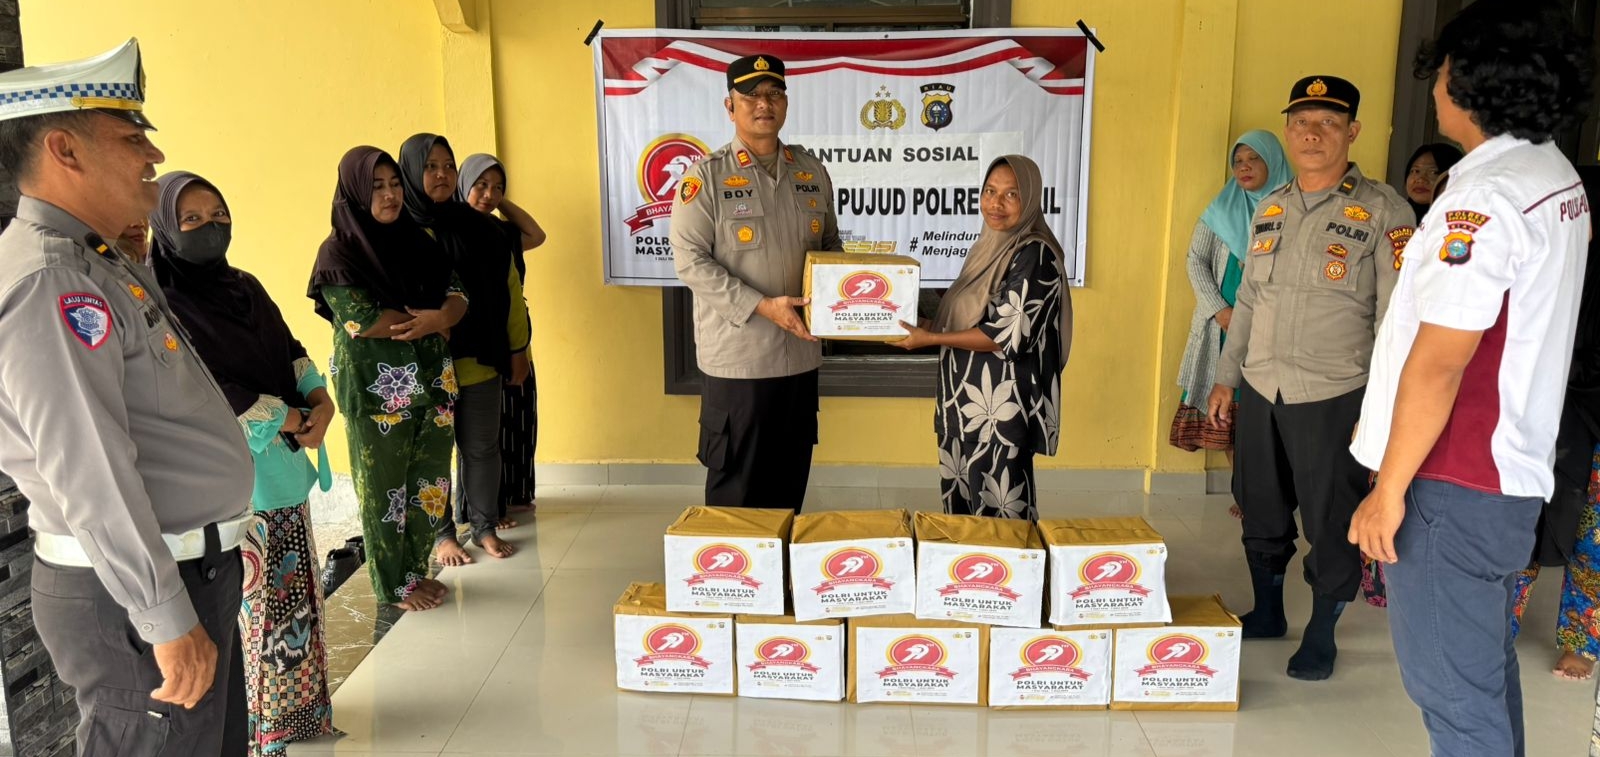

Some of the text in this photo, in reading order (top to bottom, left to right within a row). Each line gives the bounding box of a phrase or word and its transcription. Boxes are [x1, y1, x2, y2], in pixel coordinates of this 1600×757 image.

[807, 146, 979, 163] ANTUAN SOSIAL
[795, 184, 820, 193] POLRI
[723, 189, 753, 199] BOY
[838, 187, 906, 216] PUJUD
[912, 187, 980, 216] POLRE
[1326, 221, 1370, 243] POLRI
[636, 236, 669, 245] POLR
[909, 231, 981, 252] # Melindun
[843, 240, 897, 254] ESISI
[921, 246, 968, 258] Menjag
[81, 298, 103, 307] LINTAS
[821, 595, 888, 603] MASYARAKAT
[944, 602, 1013, 610] MASYARAKAT
[1075, 601, 1144, 609] MASYARAKAT
